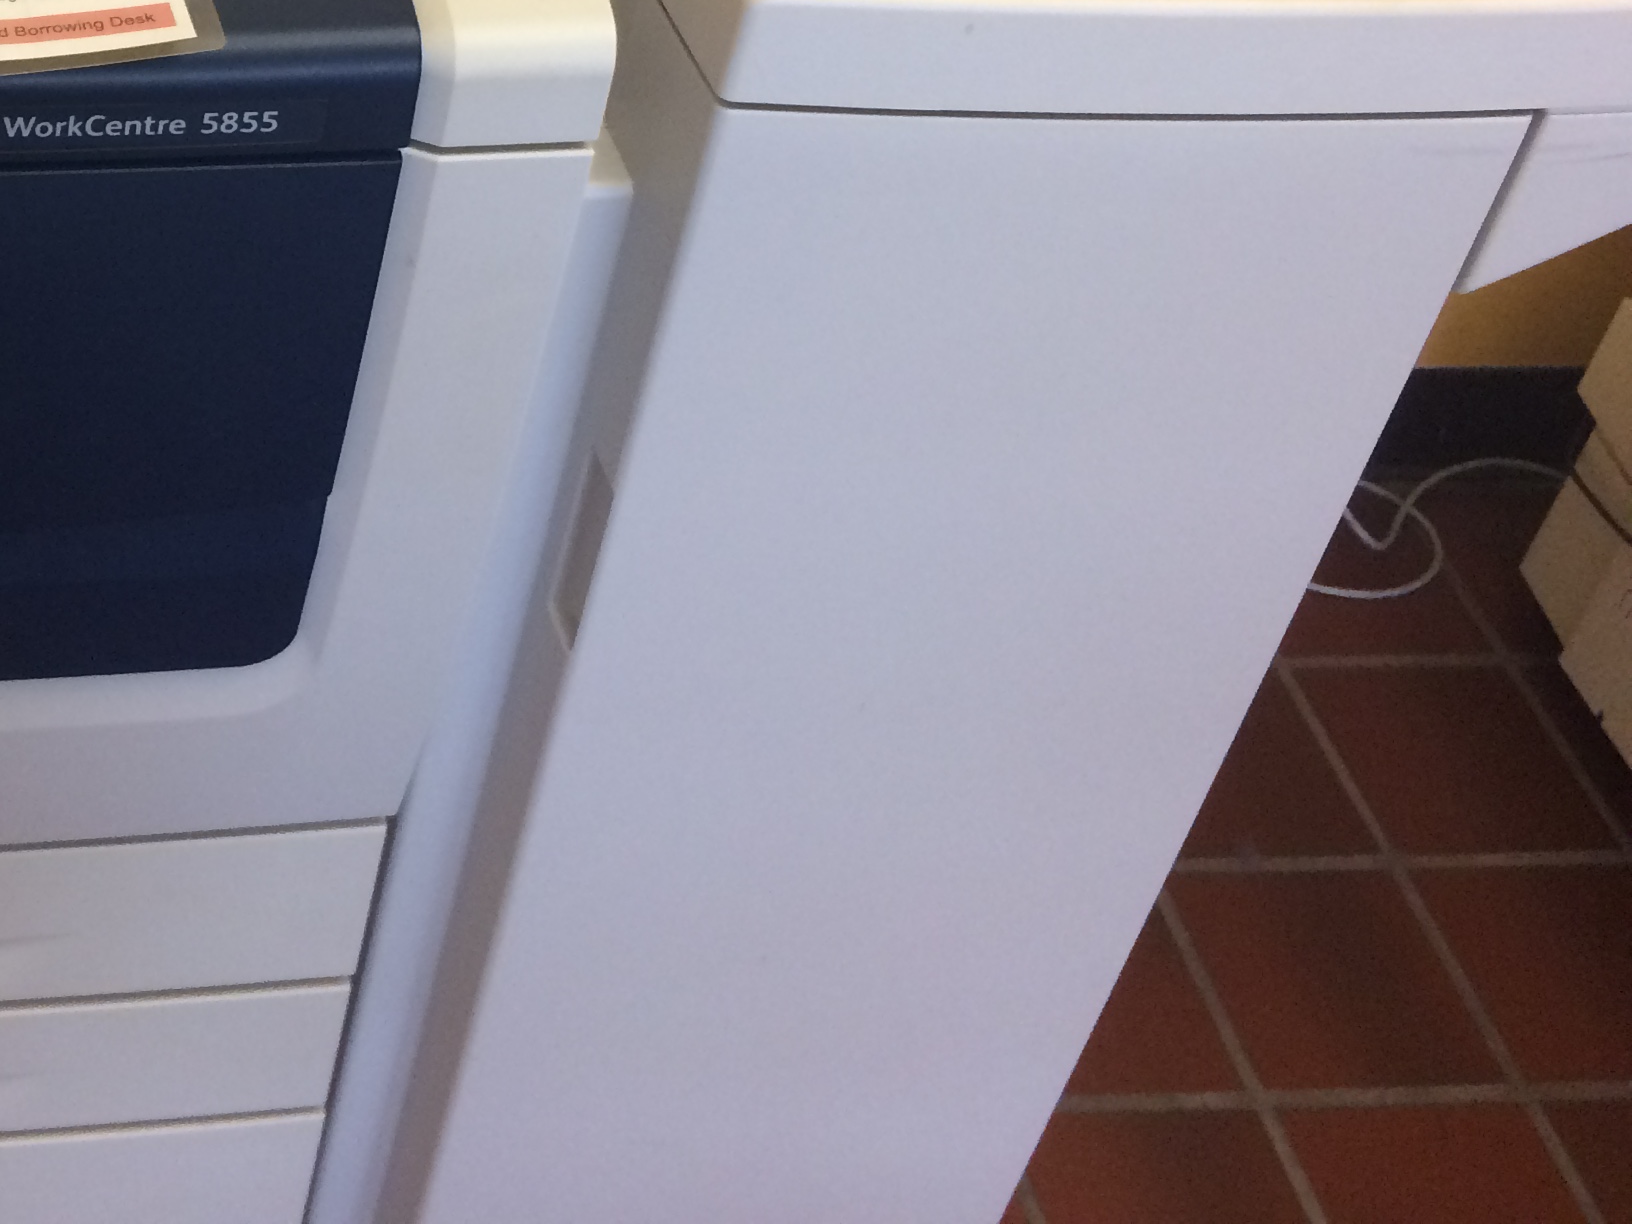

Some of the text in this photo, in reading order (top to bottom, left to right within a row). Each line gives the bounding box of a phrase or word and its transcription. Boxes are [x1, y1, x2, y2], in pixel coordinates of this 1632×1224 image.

[14, 17, 105, 38] Borrowing
[110, 12, 157, 27] Desk
[3, 111, 279, 138] WorkCentre 5855
